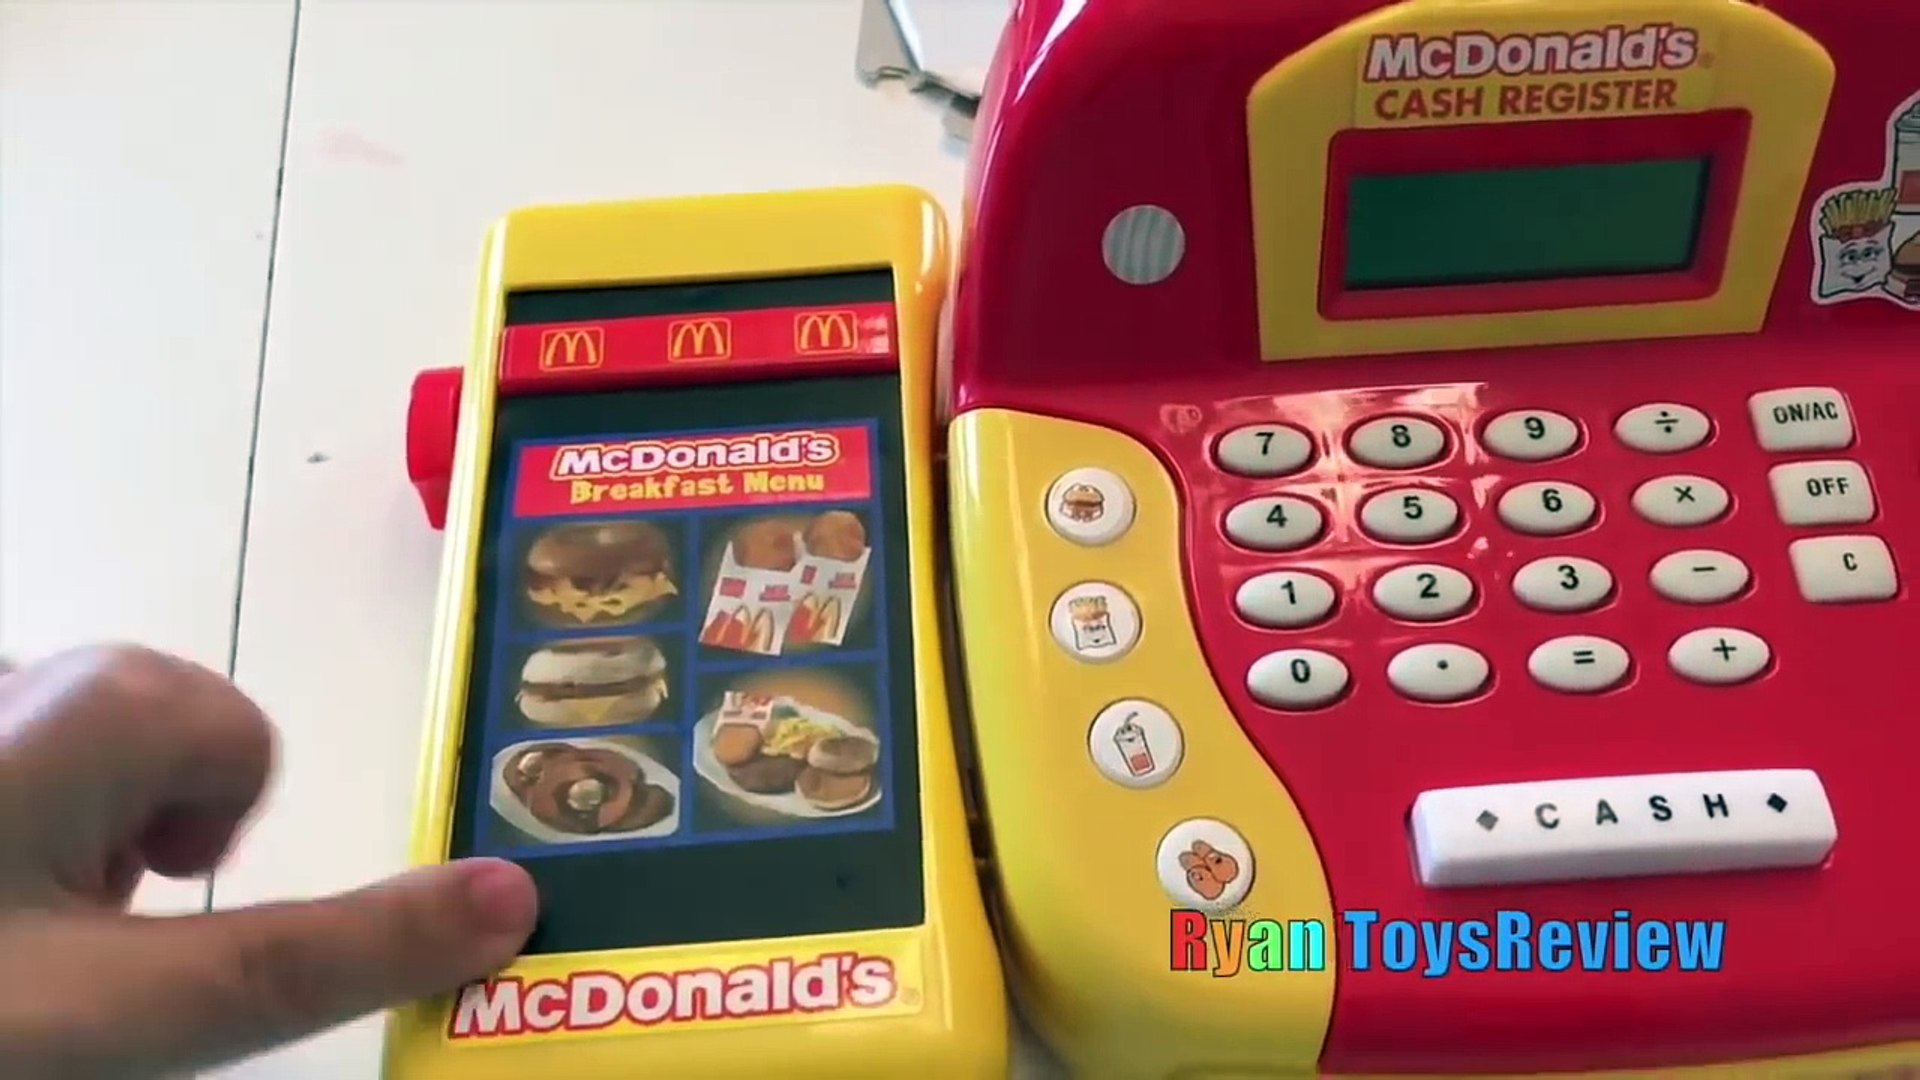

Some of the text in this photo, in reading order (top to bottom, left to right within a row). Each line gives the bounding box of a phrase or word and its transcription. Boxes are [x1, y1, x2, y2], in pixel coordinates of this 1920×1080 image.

[1364, 23, 1698, 82] McDonald's
[1374, 79, 1679, 120] CASH REGISTER
[1773, 401, 1839, 424] ON/AC
[1255, 431, 1275, 455] 7
[1391, 424, 1411, 448] 8
[1524, 416, 1545, 440] 9
[553, 433, 838, 478] McDonald's
[570, 471, 825, 504] Breakfast Menu
[1806, 477, 1850, 497] OFF
[1266, 504, 1287, 528] 4
[1403, 495, 1423, 520] 5
[1542, 488, 1563, 512] 6
[1843, 552, 1859, 572] C
[1281, 580, 1297, 605] 1
[1417, 573, 1440, 599] 2
[1558, 564, 1580, 590] 3
[1290, 658, 1311, 683] 0
[448, 951, 896, 1039] McDonald's
